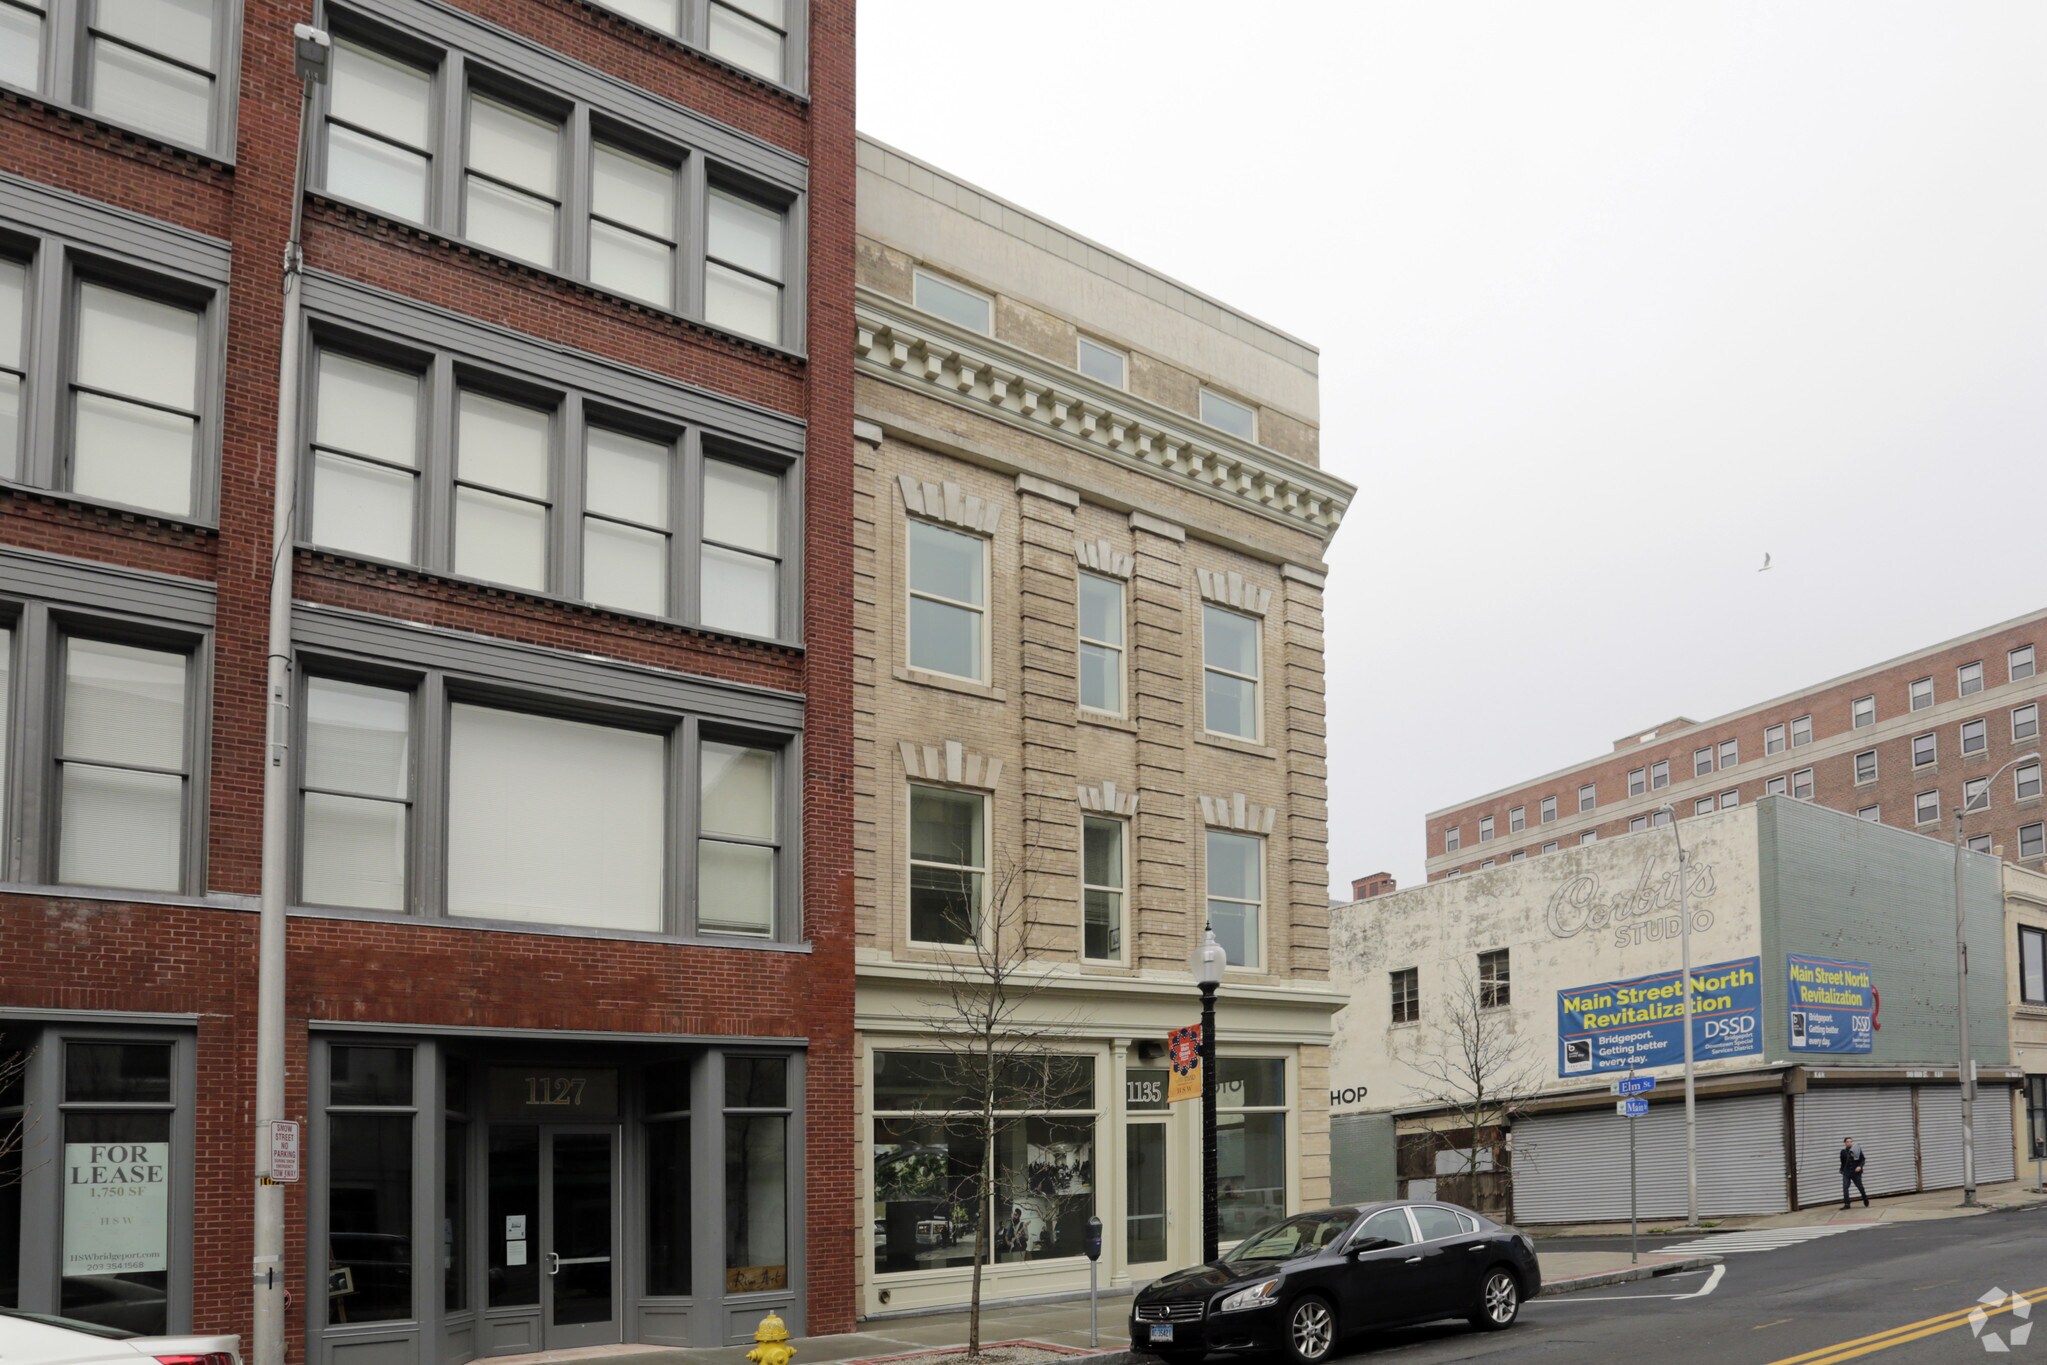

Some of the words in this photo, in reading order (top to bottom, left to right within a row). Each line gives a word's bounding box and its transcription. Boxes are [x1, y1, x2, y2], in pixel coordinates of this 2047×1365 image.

[1790, 965, 1814, 982] Main
[1815, 967, 1843, 985] Street
[1845, 970, 1869, 988] North
[1563, 993, 1612, 1014] Main
[1617, 980, 1683, 1005] Street
[1689, 968, 1754, 994] North
[1800, 985, 1863, 1006] Revitalization
[1584, 995, 1731, 1030] Revitalization
[1704, 1015, 1755, 1038] DSSD
[1852, 1015, 1870, 1032] DSSD
[1598, 1030, 1654, 1045] Bridgeport.
[1599, 1045, 1635, 1056] Getting
[1636, 1040, 1668, 1051] better
[1599, 1057, 1626, 1067] every
[1627, 1054, 1648, 1064] day.
[525, 1077, 587, 1106] 1127
[1127, 1081, 1162, 1103] 1135
[1622, 1081, 1641, 1092] Elm
[1330, 1086, 1368, 1106] HOP
[1627, 1102, 1644, 1112] Main
[277, 1124, 293, 1132] SNOW
[275, 1133, 294, 1141] STREET
[281, 1142, 289, 1150] NO
[90, 1145, 149, 1164] FOR
[274, 1150, 296, 1159] PARKING
[70, 1165, 163, 1185] LEASE
[274, 1169, 283, 1177] TOW
[284, 1170, 296, 1178] AWAY
[90, 1187, 124, 1198] 1,750
[128, 1186, 147, 1197] SF
[70, 1251, 160, 1262] HSWbridgeport.com
